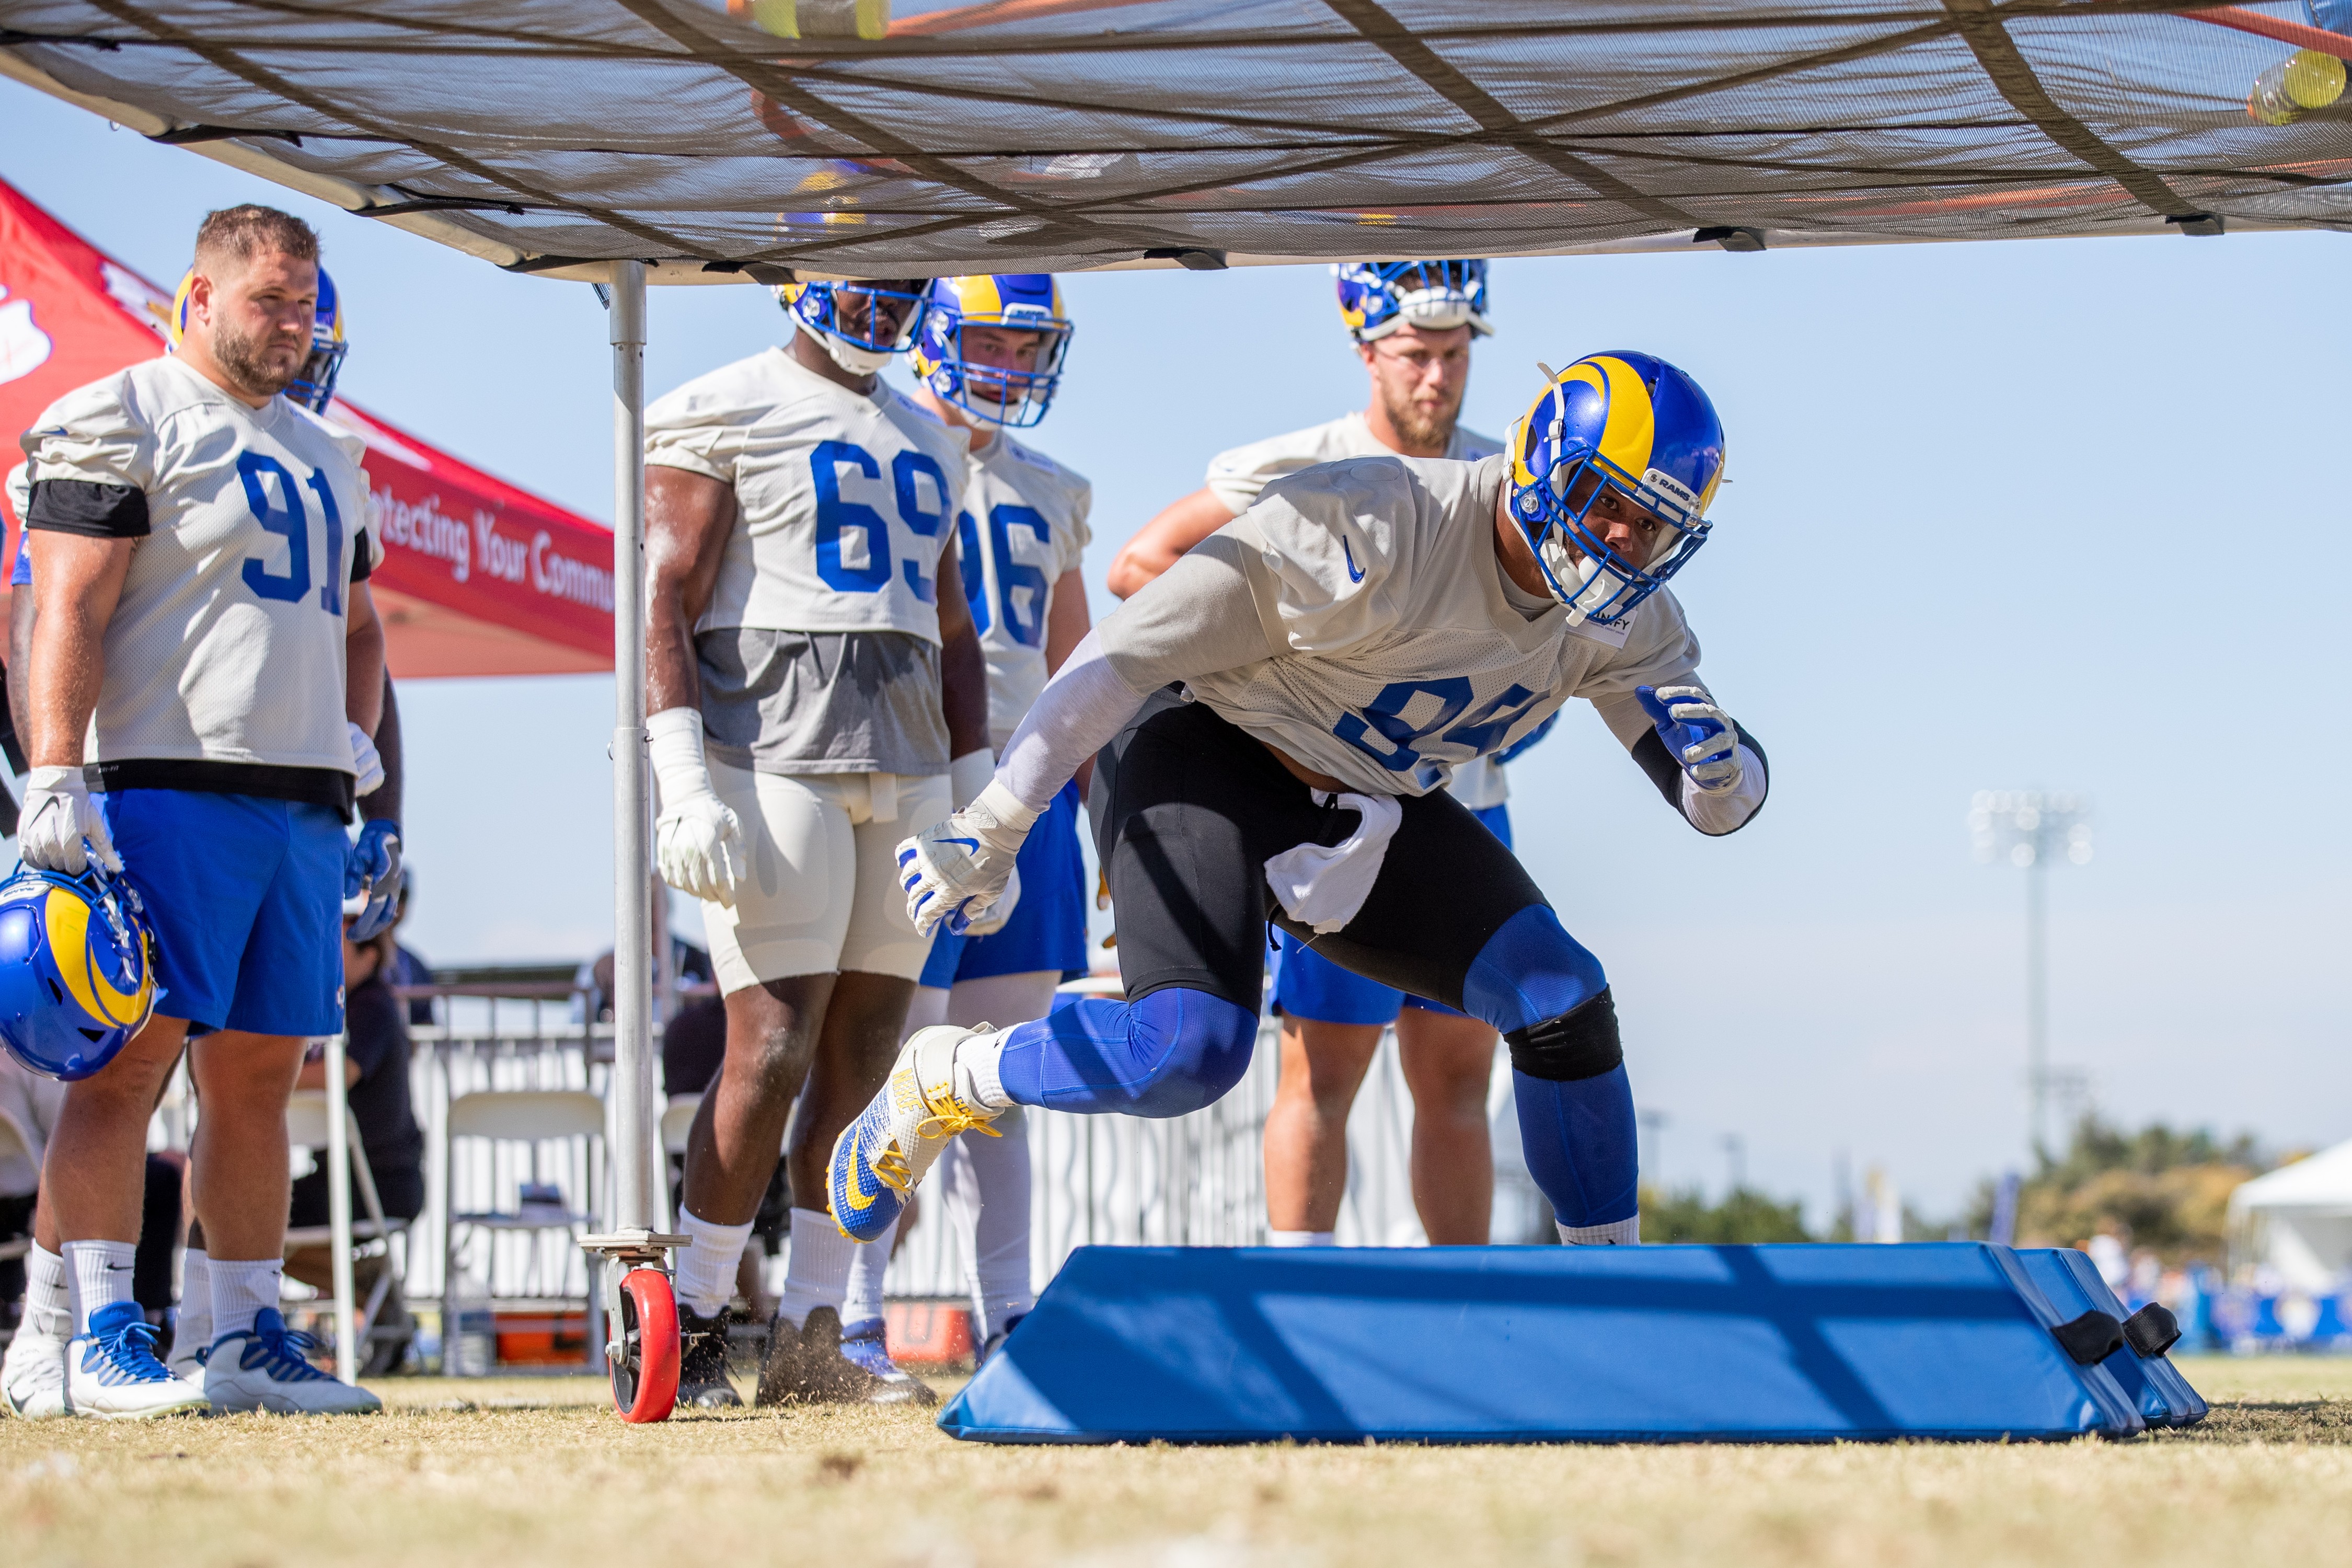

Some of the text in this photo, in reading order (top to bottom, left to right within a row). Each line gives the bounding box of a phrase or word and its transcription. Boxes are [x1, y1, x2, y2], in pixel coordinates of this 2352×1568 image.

[1659, 479, 1690, 501] RAMS
[236, 450, 343, 616] 91
[474, 508, 528, 585] Your
[810, 440, 952, 605] 69
[1597, 612, 1630, 630] NFY
[892, 1067, 925, 1115] NIKE
